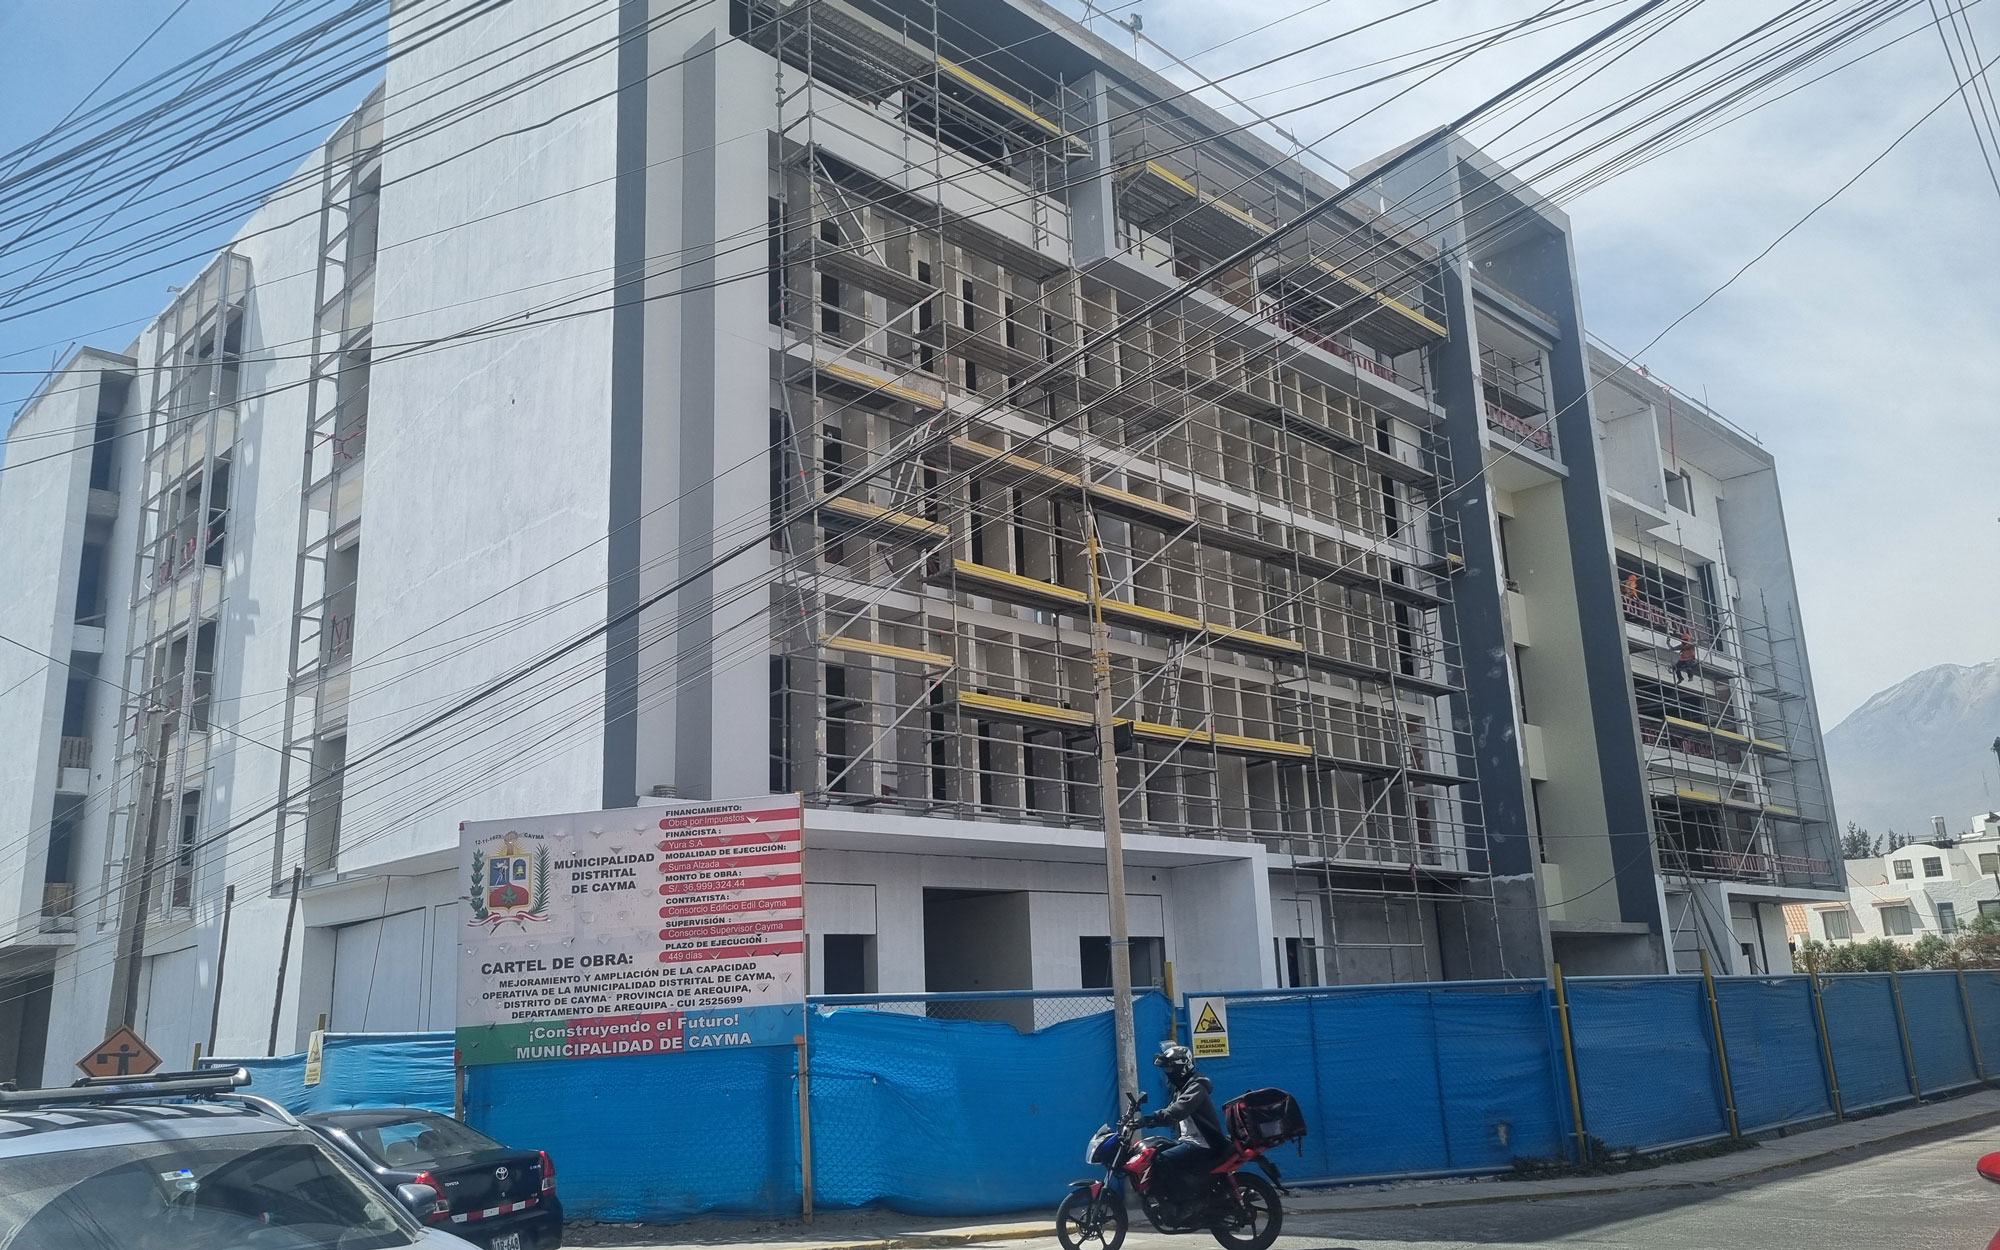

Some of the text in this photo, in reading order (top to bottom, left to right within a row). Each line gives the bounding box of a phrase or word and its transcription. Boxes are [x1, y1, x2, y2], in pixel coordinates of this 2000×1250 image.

[666, 805, 742, 817] FINANCIAMIENTO:
[668, 814, 745, 828] Obra por Impuestos
[524, 832, 545, 840] CAYMA
[666, 828, 717, 838] FINANCISTA
[666, 850, 717, 860] MODALIDAD
[733, 844, 786, 854] EJECUCIÓN:
[668, 841, 687, 849] Yura
[554, 853, 655, 870] MUNICIPALIDAD
[668, 860, 720, 871] Suma Alzada
[571, 868, 636, 881] DISTRITAL
[666, 874, 697, 882] MONTO
[713, 870, 742, 878] OBRA:
[571, 881, 636, 894] DE CAYMA
[666, 894, 730, 905] CONTRATISTA:
[668, 899, 787, 915] Consorcio Edificio Edil Cayma
[666, 916, 725, 928] SUPERVISIÓN
[668, 922, 784, 938] Consorcio Supervisor Cayma
[666, 942, 694, 950] PLAZO
[710, 935, 762, 947] EJECUCIÓN
[685, 951, 703, 960] días
[481, 953, 633, 975] CARTEL DE OBRA:
[499, 962, 757, 988] MEJORAMIENTO Y AMPLIACIÓN DE LA CAPACIDAD
[482, 972, 775, 1000] OPERATIVA DE LA MUNICIPALIDAD DISTRITAL DE CAYMA,
[504, 999, 551, 1009] DISTRITO
[570, 995, 607, 1004] CAYMA
[616, 990, 674, 1001] PROVINCIA
[677, 988, 691, 997] DE
[694, 984, 751, 995] AREQUIPA,
[511, 1006, 594, 1019] DEPARTAMENTO
[597, 1005, 611, 1013] DE
[614, 1001, 667, 1012] AREQUIPA
[677, 998, 696, 1007] CUI
[698, 996, 743, 1006] 2525699
[529, 1014, 739, 1042] ¡Construyendo el Futuro!
[516, 1032, 752, 1060] MUNICIPALIDAD DE CAYMA
